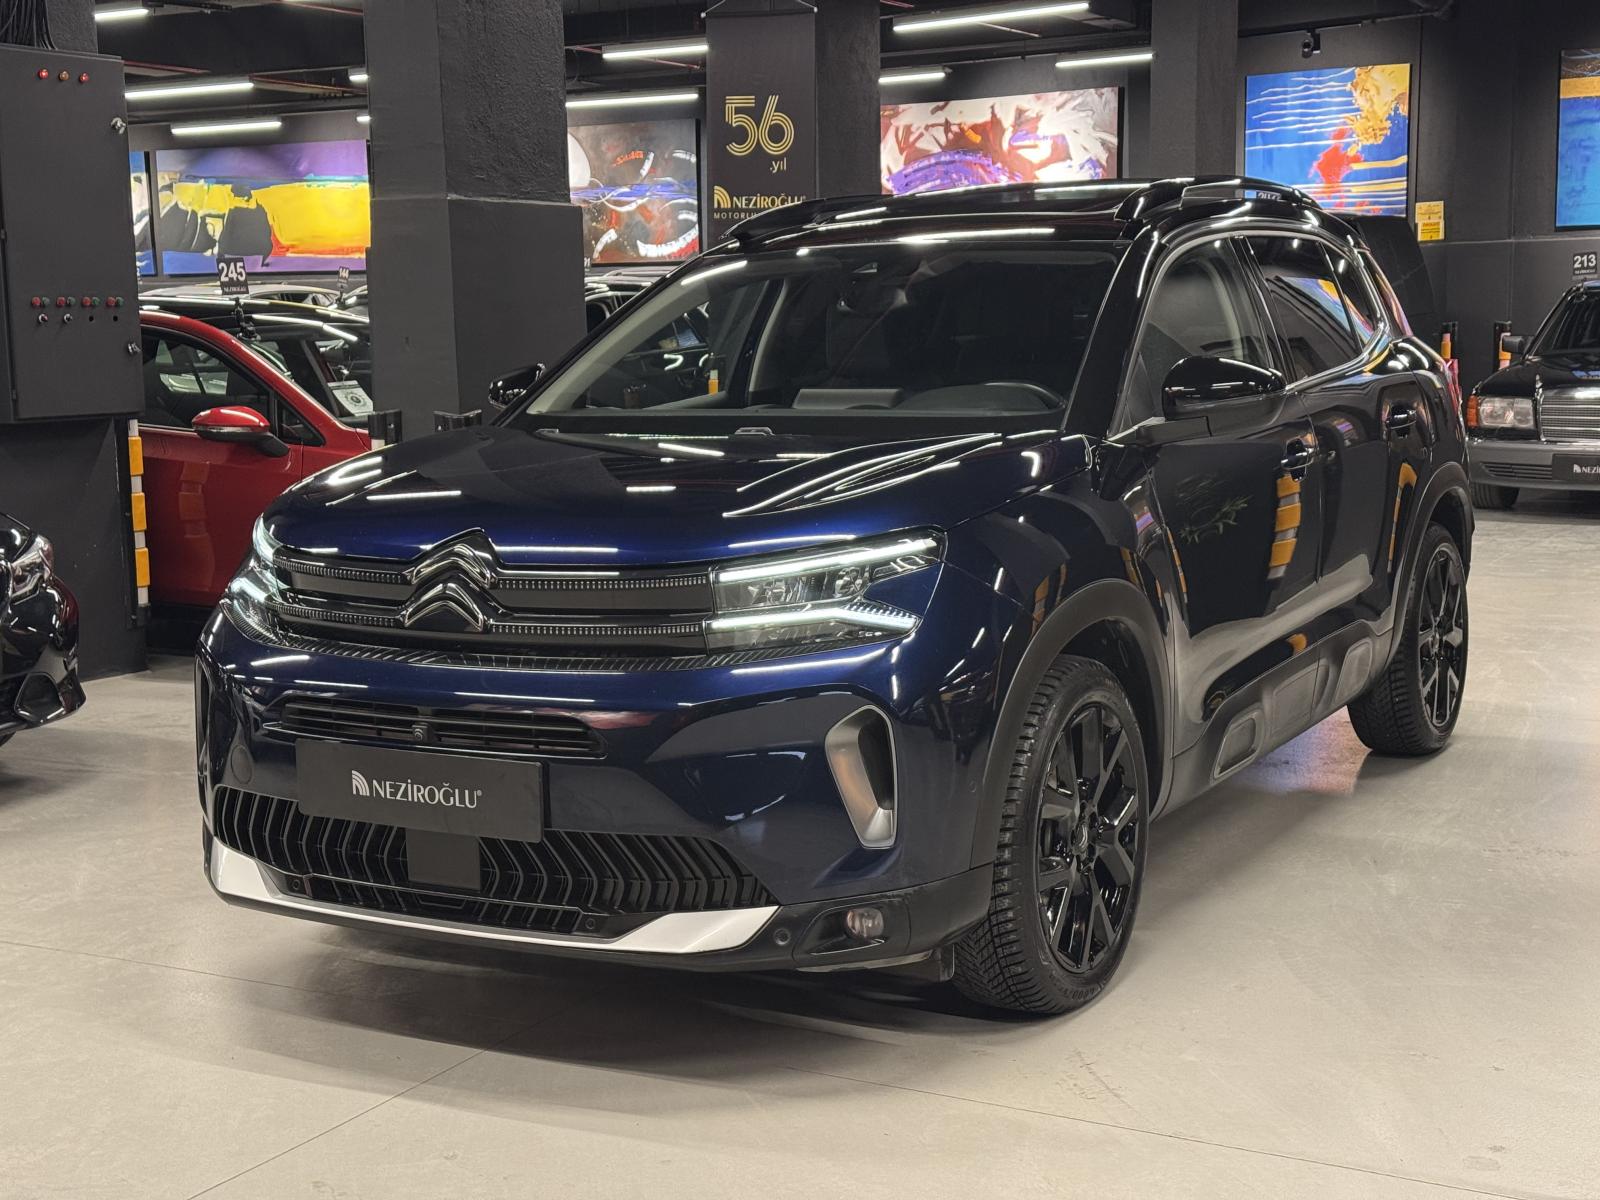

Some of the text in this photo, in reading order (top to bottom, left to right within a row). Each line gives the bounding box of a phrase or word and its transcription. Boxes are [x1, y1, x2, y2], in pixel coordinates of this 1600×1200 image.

[725, 95, 795, 156] 56
[218, 262, 246, 282] 245
[1573, 254, 1596, 268] 213
[372, 778, 479, 809] NEZİROĞLU
